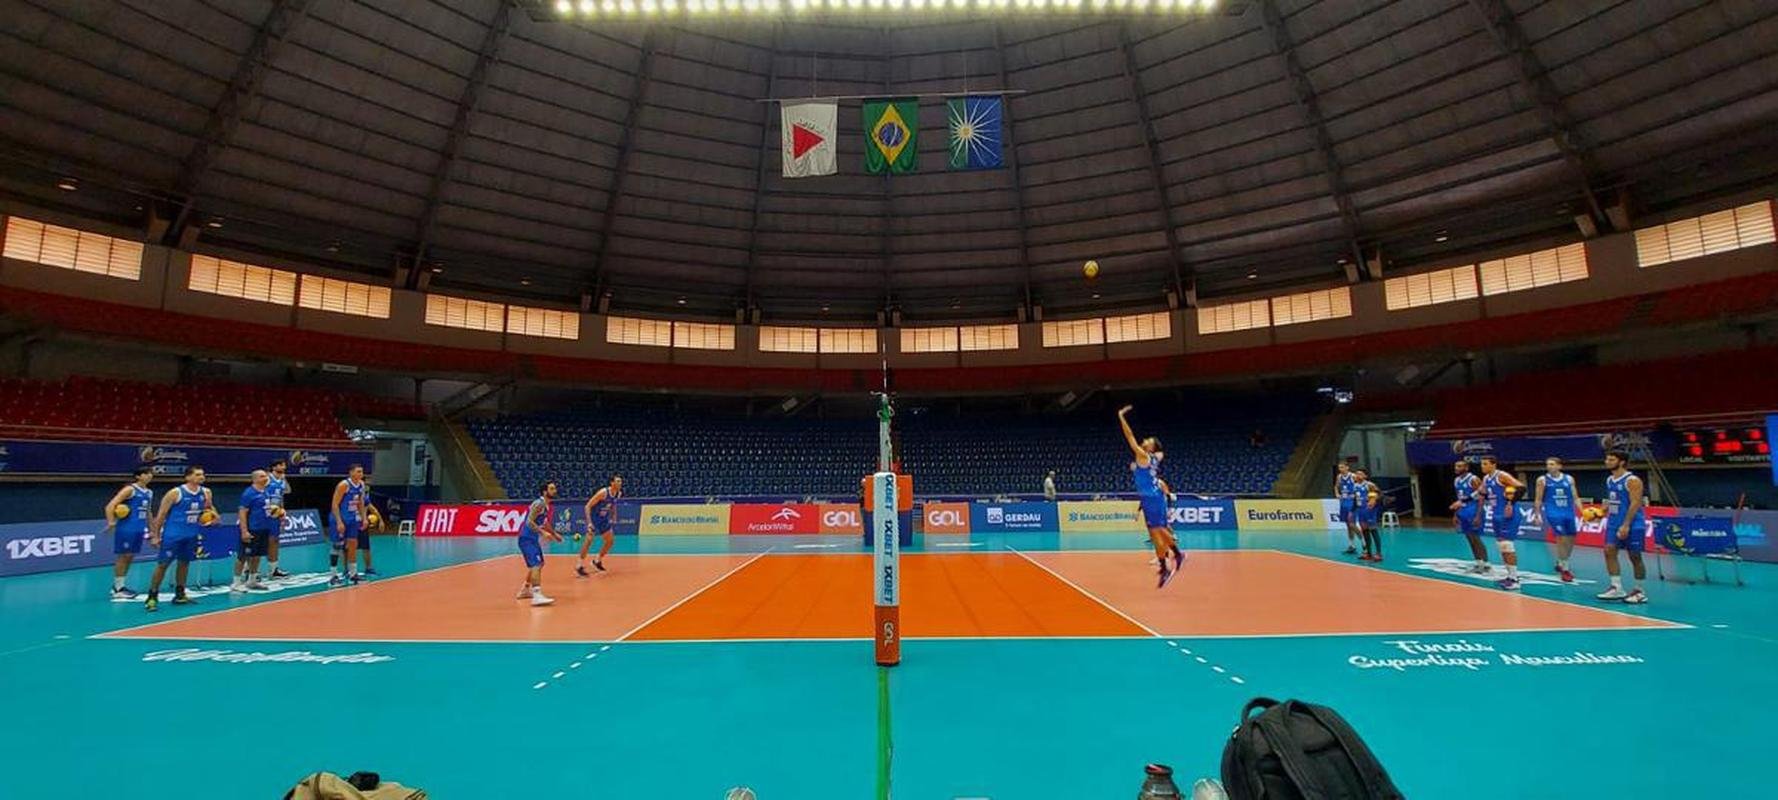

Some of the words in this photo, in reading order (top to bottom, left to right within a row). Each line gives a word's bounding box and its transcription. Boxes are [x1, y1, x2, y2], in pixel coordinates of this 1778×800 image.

[421, 508, 457, 532] FIAT
[475, 509, 527, 533] SKY
[823, 510, 860, 527] GOL
[928, 510, 965, 526] GOL
[1005, 513, 1041, 522] GERDAU
[1167, 507, 1223, 523] XBET
[1248, 509, 1314, 521] Eurofarma
[6, 534, 95, 560] 1XBET
[884, 519, 894, 558] 1XBET
[884, 565, 894, 603] 1XBET
[883, 621, 895, 646] GOL
